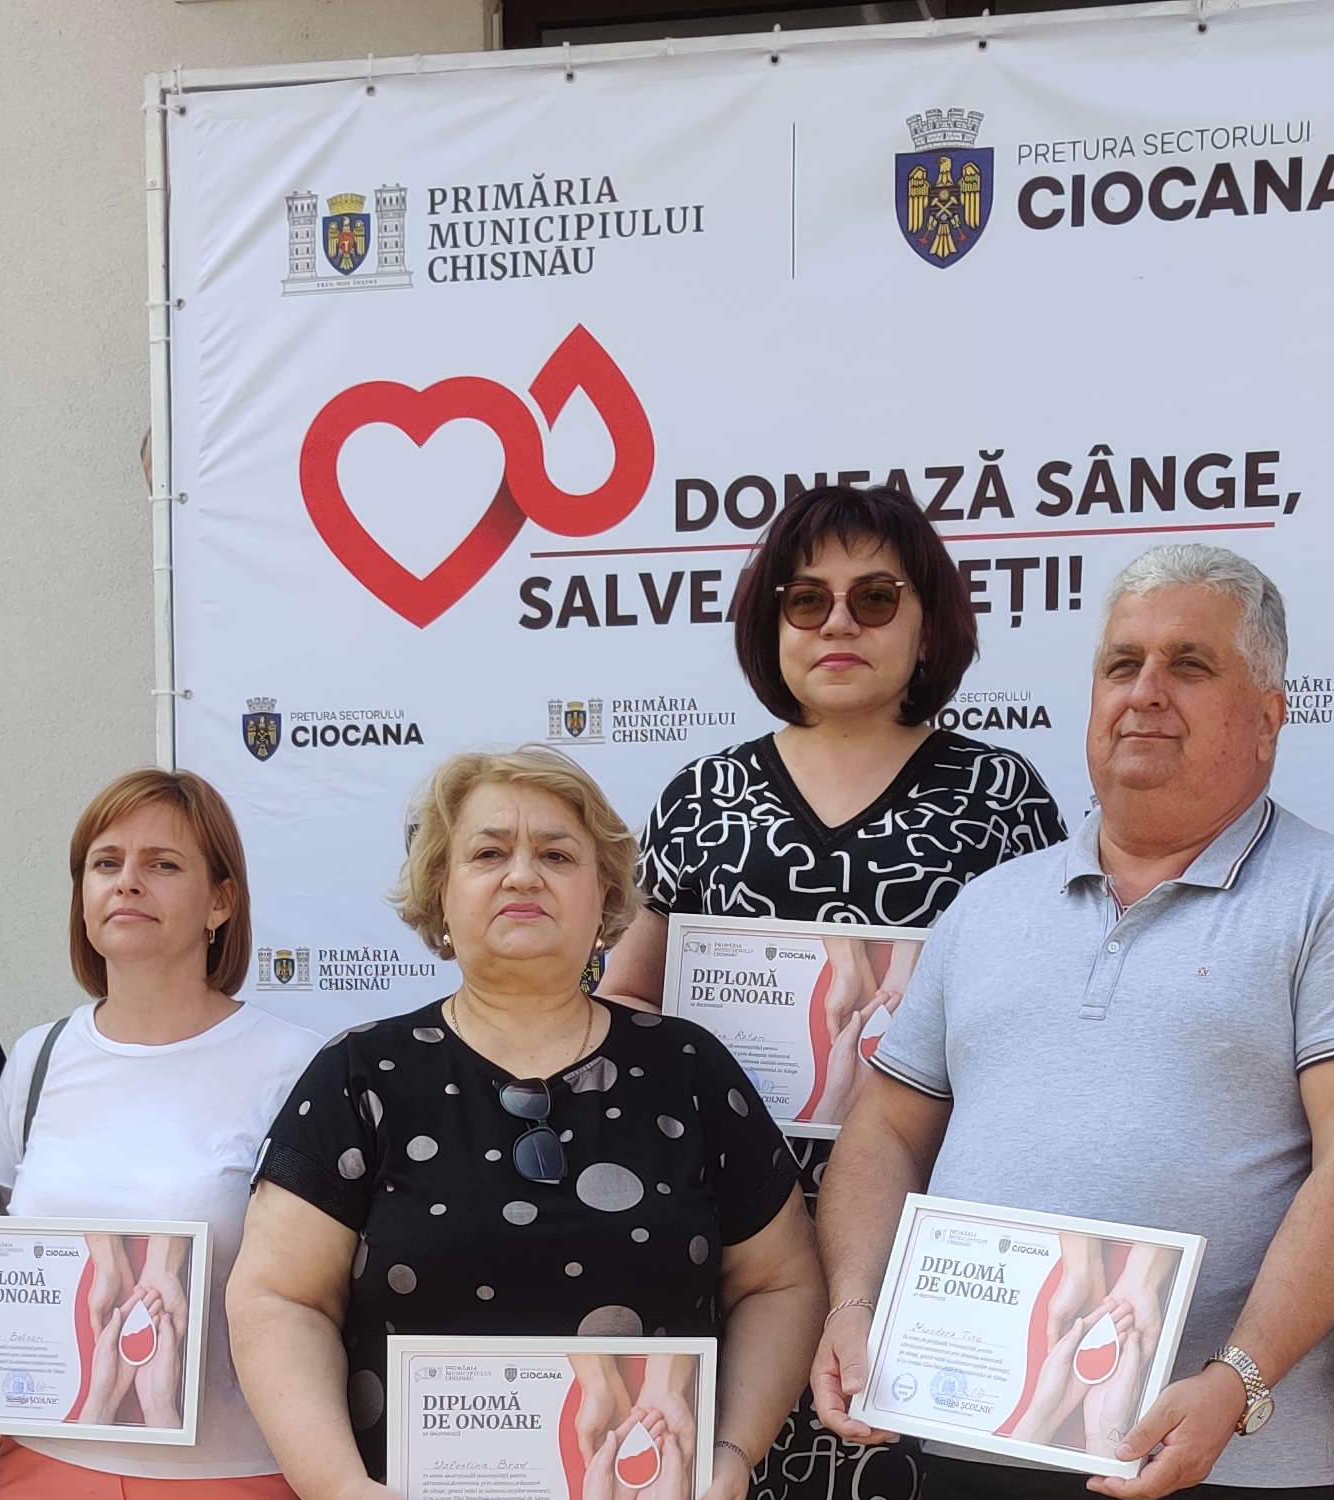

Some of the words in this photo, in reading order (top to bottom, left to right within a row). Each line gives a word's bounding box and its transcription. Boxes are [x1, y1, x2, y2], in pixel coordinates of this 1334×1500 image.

[1017, 135, 1136, 166] PRETURA
[1142, 120, 1311, 156] SECTORULUI
[427, 173, 619, 215] PRIMĂRIA
[427, 205, 704, 250] MUNICIPIULUI
[1036, 443, 1302, 517] SÂNGE,
[519, 568, 752, 630] SALVE
[958, 555, 1082, 628] EȚI!
[612, 695, 698, 713] PRIMĂRIA
[959, 690, 1031, 703] SECTORULUI
[290, 711, 337, 722] PRETURA
[339, 709, 405, 720] SECTORULUI
[612, 712, 736, 728] MUNICIPIULUI
[931, 705, 1052, 731] OCANA
[290, 723, 424, 748] CIOCANA
[318, 946, 400, 962] PRIMĂRIA
[318, 963, 436, 977] MUNICIPIULUI
[692, 967, 778, 988] DIPLOMĂ
[690, 986, 715, 1001] DE
[719, 987, 795, 1007] ONOARE
[761, 1095, 790, 1105] COLNIC
[920, 1255, 1007, 1284] DIPLOMĂ
[915, 1274, 940, 1293] DE
[943, 1279, 1021, 1306] ONOARE
[422, 1390, 522, 1411] DIPLOMĂ
[422, 1414, 451, 1429] DE
[455, 1413, 542, 1430] ONOARE
